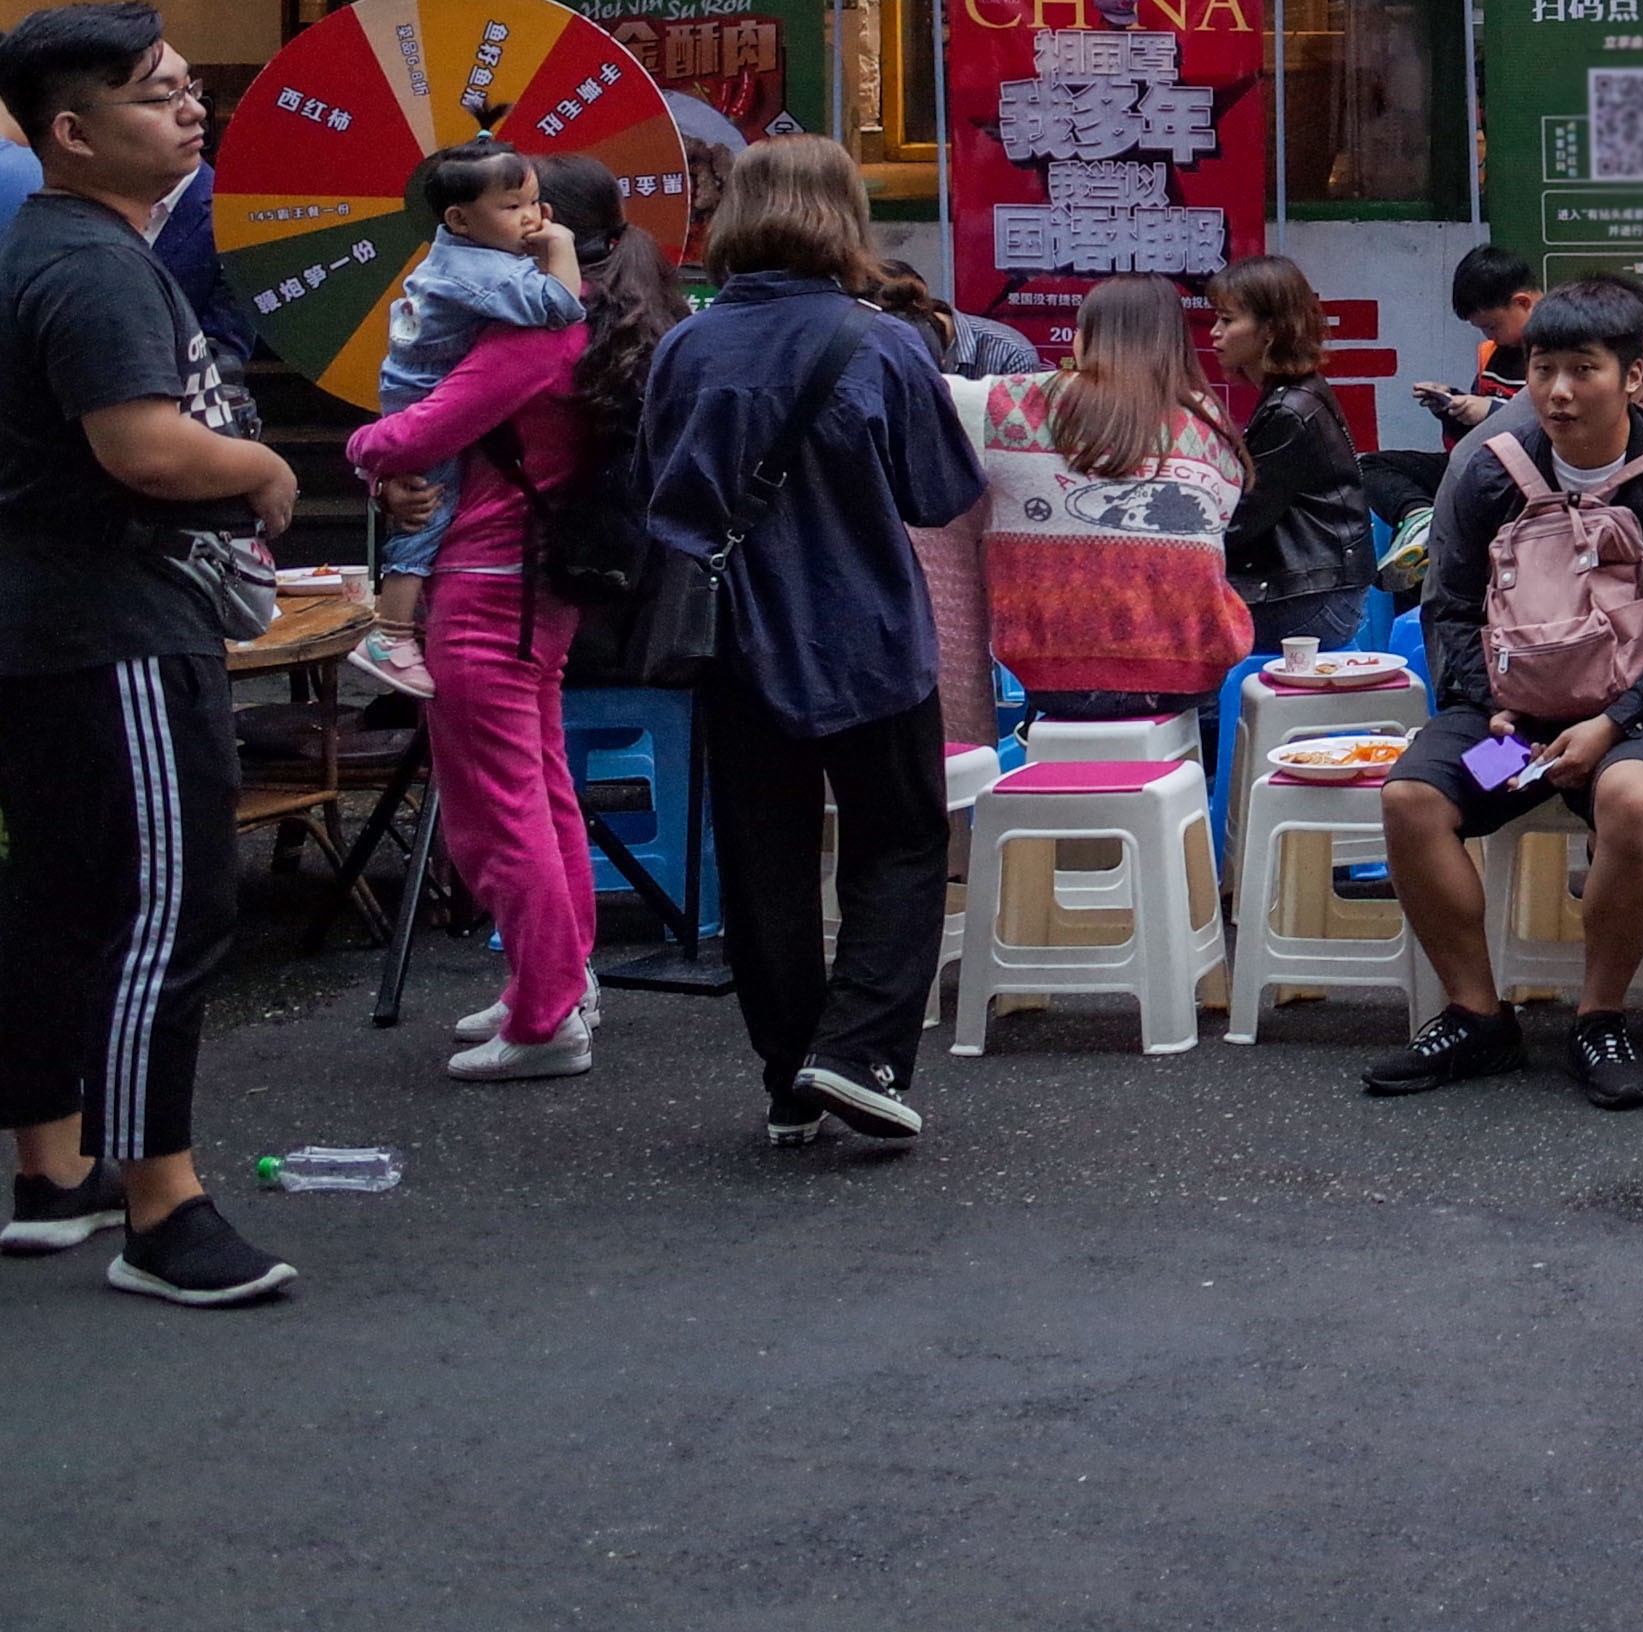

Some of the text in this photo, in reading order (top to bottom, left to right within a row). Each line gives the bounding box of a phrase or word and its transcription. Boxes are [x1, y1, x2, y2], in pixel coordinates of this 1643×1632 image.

[666, 0, 695, 20] Su
[276, 86, 353, 132] 西红柿
[536, 63, 623, 137] 手撕毛肚
